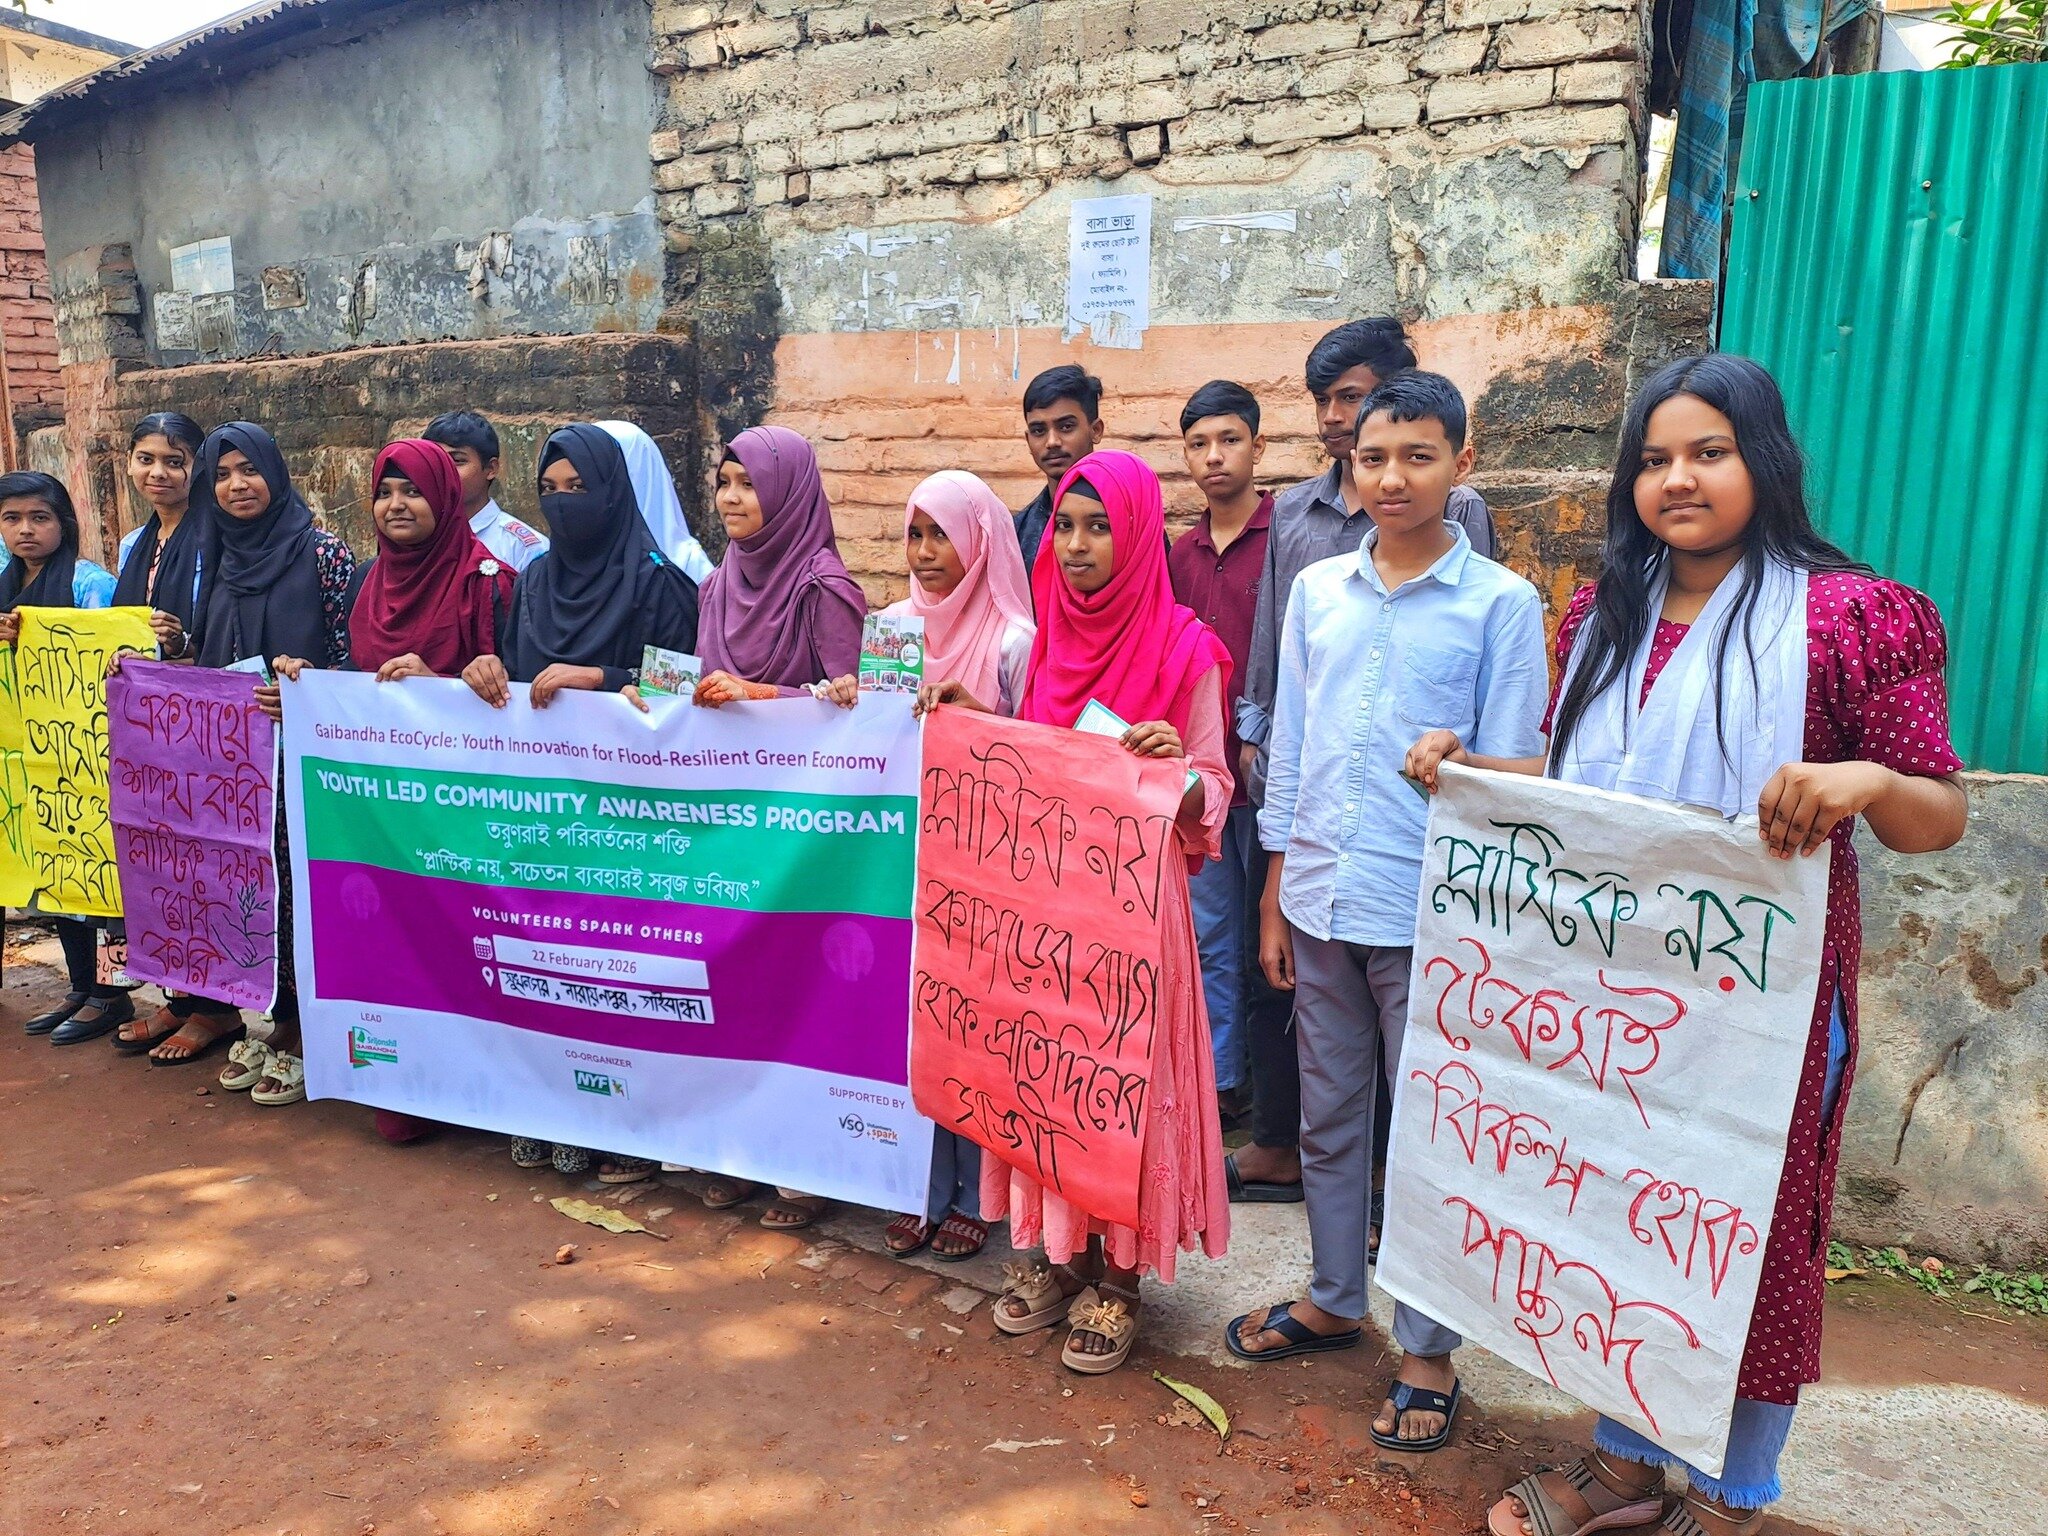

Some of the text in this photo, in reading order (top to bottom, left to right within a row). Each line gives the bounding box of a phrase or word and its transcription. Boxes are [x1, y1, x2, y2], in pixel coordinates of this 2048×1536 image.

[1086, 214, 1136, 230] বাসা ভাড়া
[123, 688, 262, 762] একসাথে
[315, 723, 887, 773] Gaibandha EcoCycle: Youth Innovation for Flood-Resilient Green Economy
[114, 757, 199, 821] শপথ
[202, 762, 275, 834] করি
[316, 769, 905, 835] YOUTH LED COMMUNITY AWARENESS PROGRAM
[486, 821, 692, 856] তরুণরাই পরিবর্তনের শক্তি
[477, 858, 505, 883] নয়,
[509, 861, 569, 884] সচেতন
[574, 866, 644, 893] ব্যবহারই
[648, 873, 689, 902] সবুজ
[1085, 806, 1175, 925] নয়
[472, 906, 704, 945] VOLUNTEERS SPARK OTHERS
[1657, 884, 1797, 993] নয়
[140, 930, 228, 988] করি
[531, 949, 638, 974] 22 February 2026
[360, 1012, 382, 1023] LEAD
[565, 1049, 633, 1068] CO-ORGANIZER
[577, 1071, 608, 1089] NYF
[829, 1086, 905, 1110] SUPPORTED BY
[839, 1116, 864, 1132] VSO
[872, 1129, 898, 1141] spark
[1410, 1061, 1758, 1299] বিকল্প হোক
